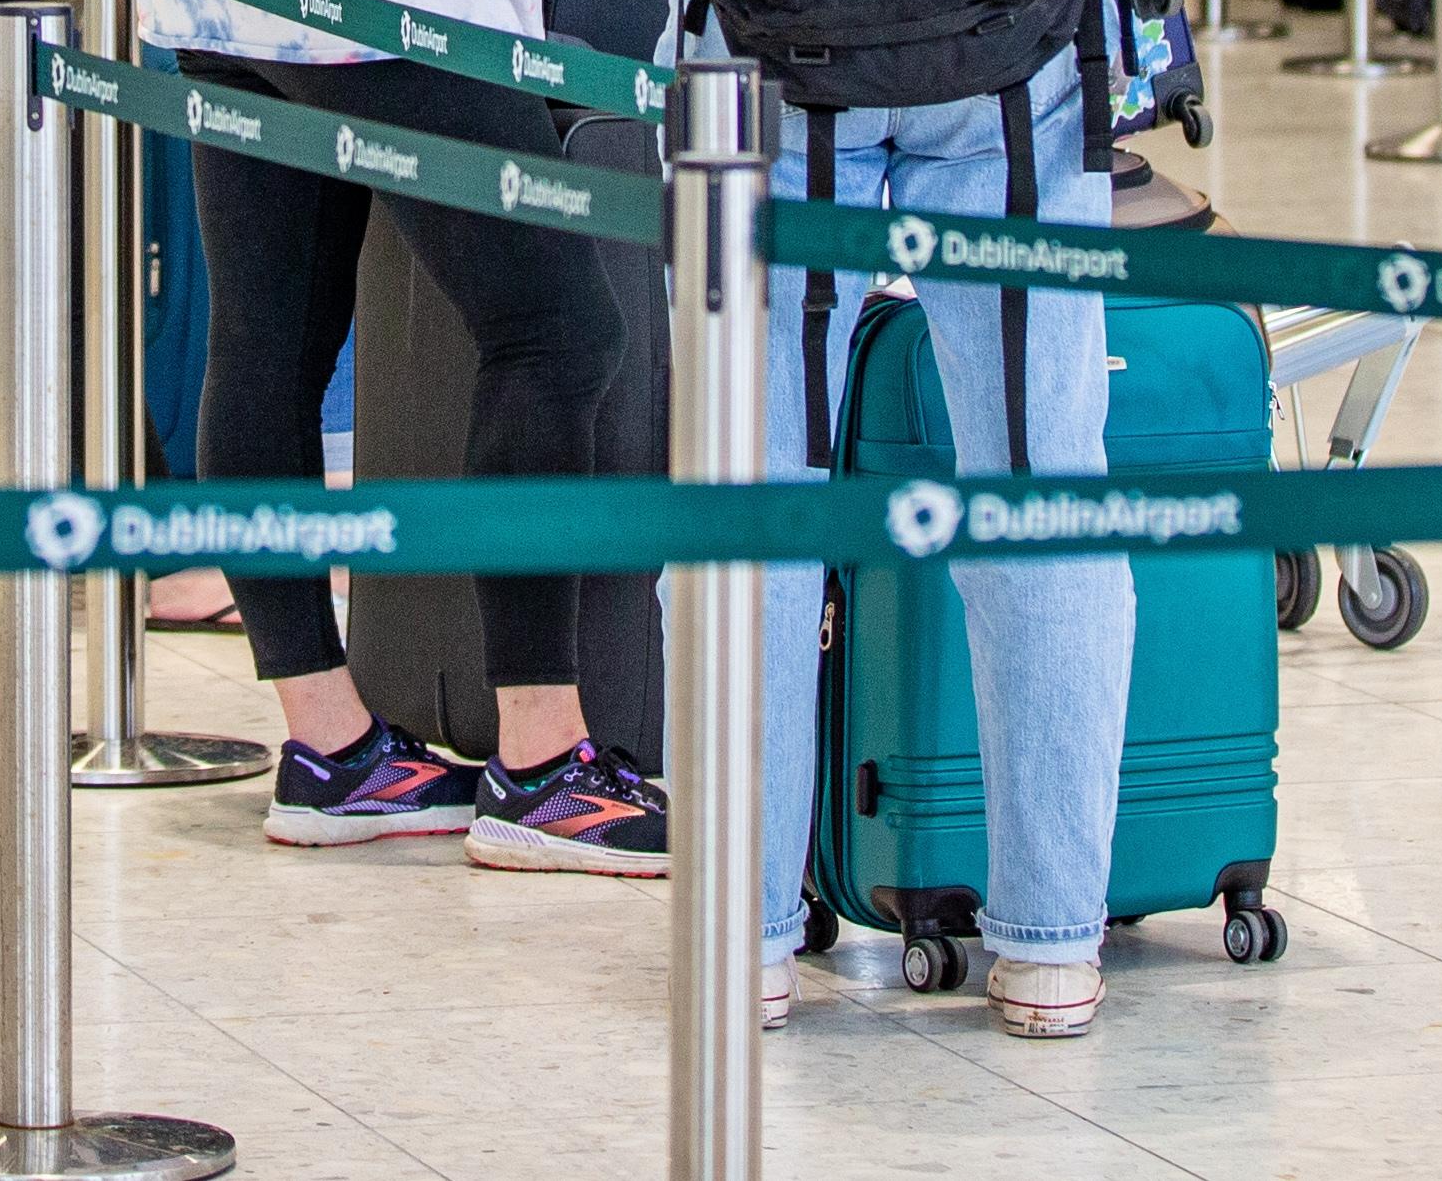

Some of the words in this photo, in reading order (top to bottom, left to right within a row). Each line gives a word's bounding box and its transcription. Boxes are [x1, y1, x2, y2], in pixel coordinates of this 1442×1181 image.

[411, 21, 449, 56] DublinAirport
[66, 65, 119, 105] DublinAirport
[941, 229, 1129, 282] DublinAirport
[111, 502, 397, 561] DublinAirport
[967, 489, 1243, 545] DublinAirport
